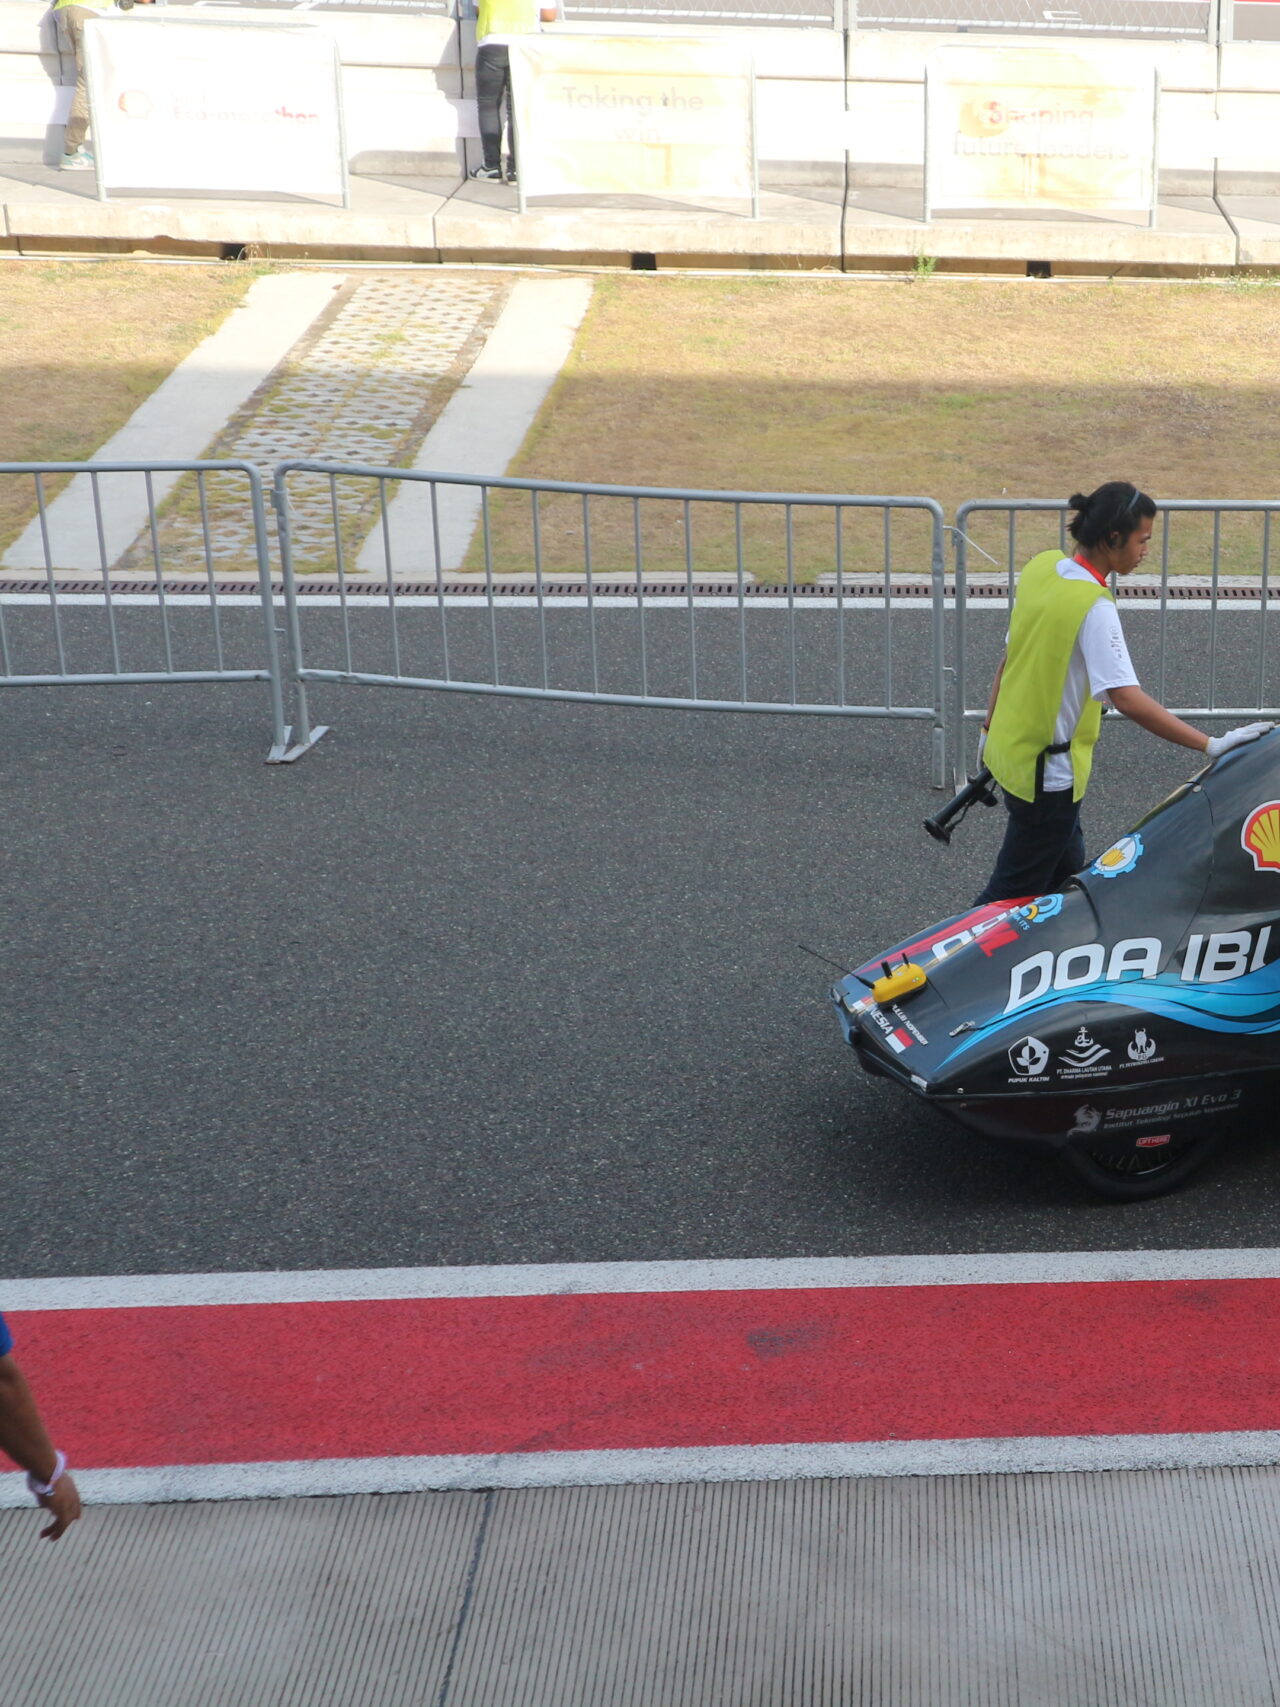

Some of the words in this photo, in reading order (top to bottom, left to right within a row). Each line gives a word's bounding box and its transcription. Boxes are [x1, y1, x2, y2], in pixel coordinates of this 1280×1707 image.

[562, 85, 652, 117] Taking
[661, 87, 705, 110] the
[954, 130, 1027, 157] future
[1036, 134, 1129, 159] leaders
[1002, 937, 1162, 1015] DOA
[1105, 1101, 1180, 1119] Sapuangin
[1183, 1096, 1199, 1109] XI
[1201, 1093, 1228, 1105] Evo
[1229, 1089, 1242, 1101] 3
